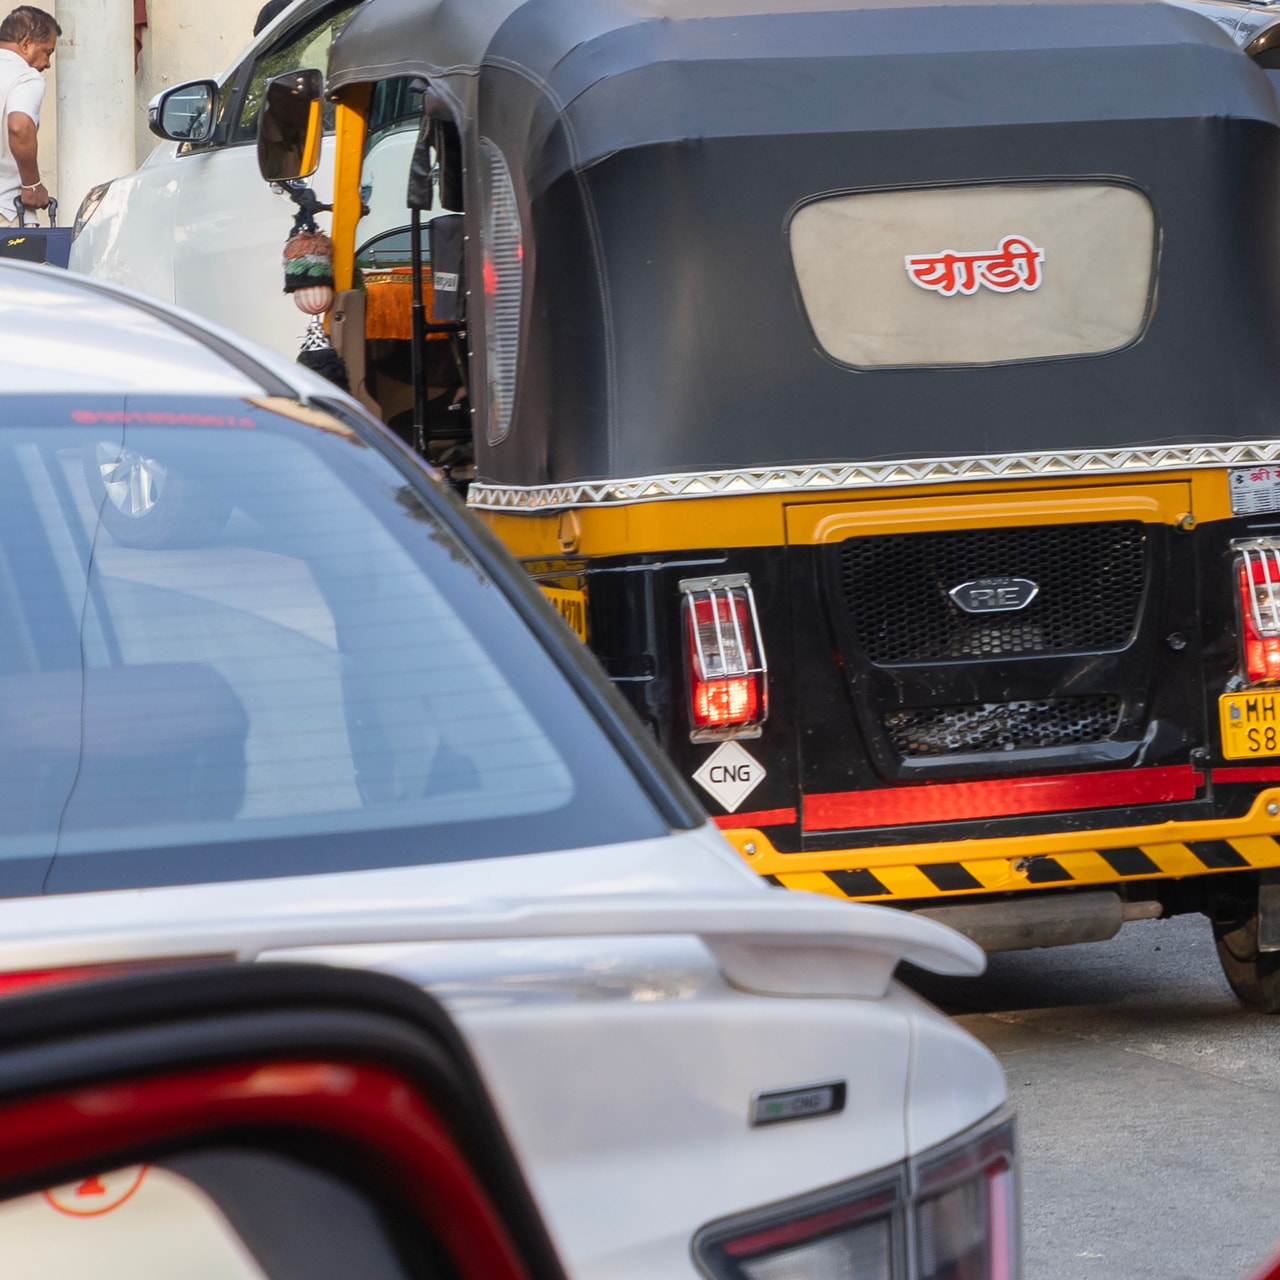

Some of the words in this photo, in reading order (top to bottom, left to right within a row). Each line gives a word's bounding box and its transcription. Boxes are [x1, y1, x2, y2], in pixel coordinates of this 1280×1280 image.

[1250, 467, 1271, 482] श्री
[969, 587, 1020, 608] RE
[710, 765, 751, 783] CNG
